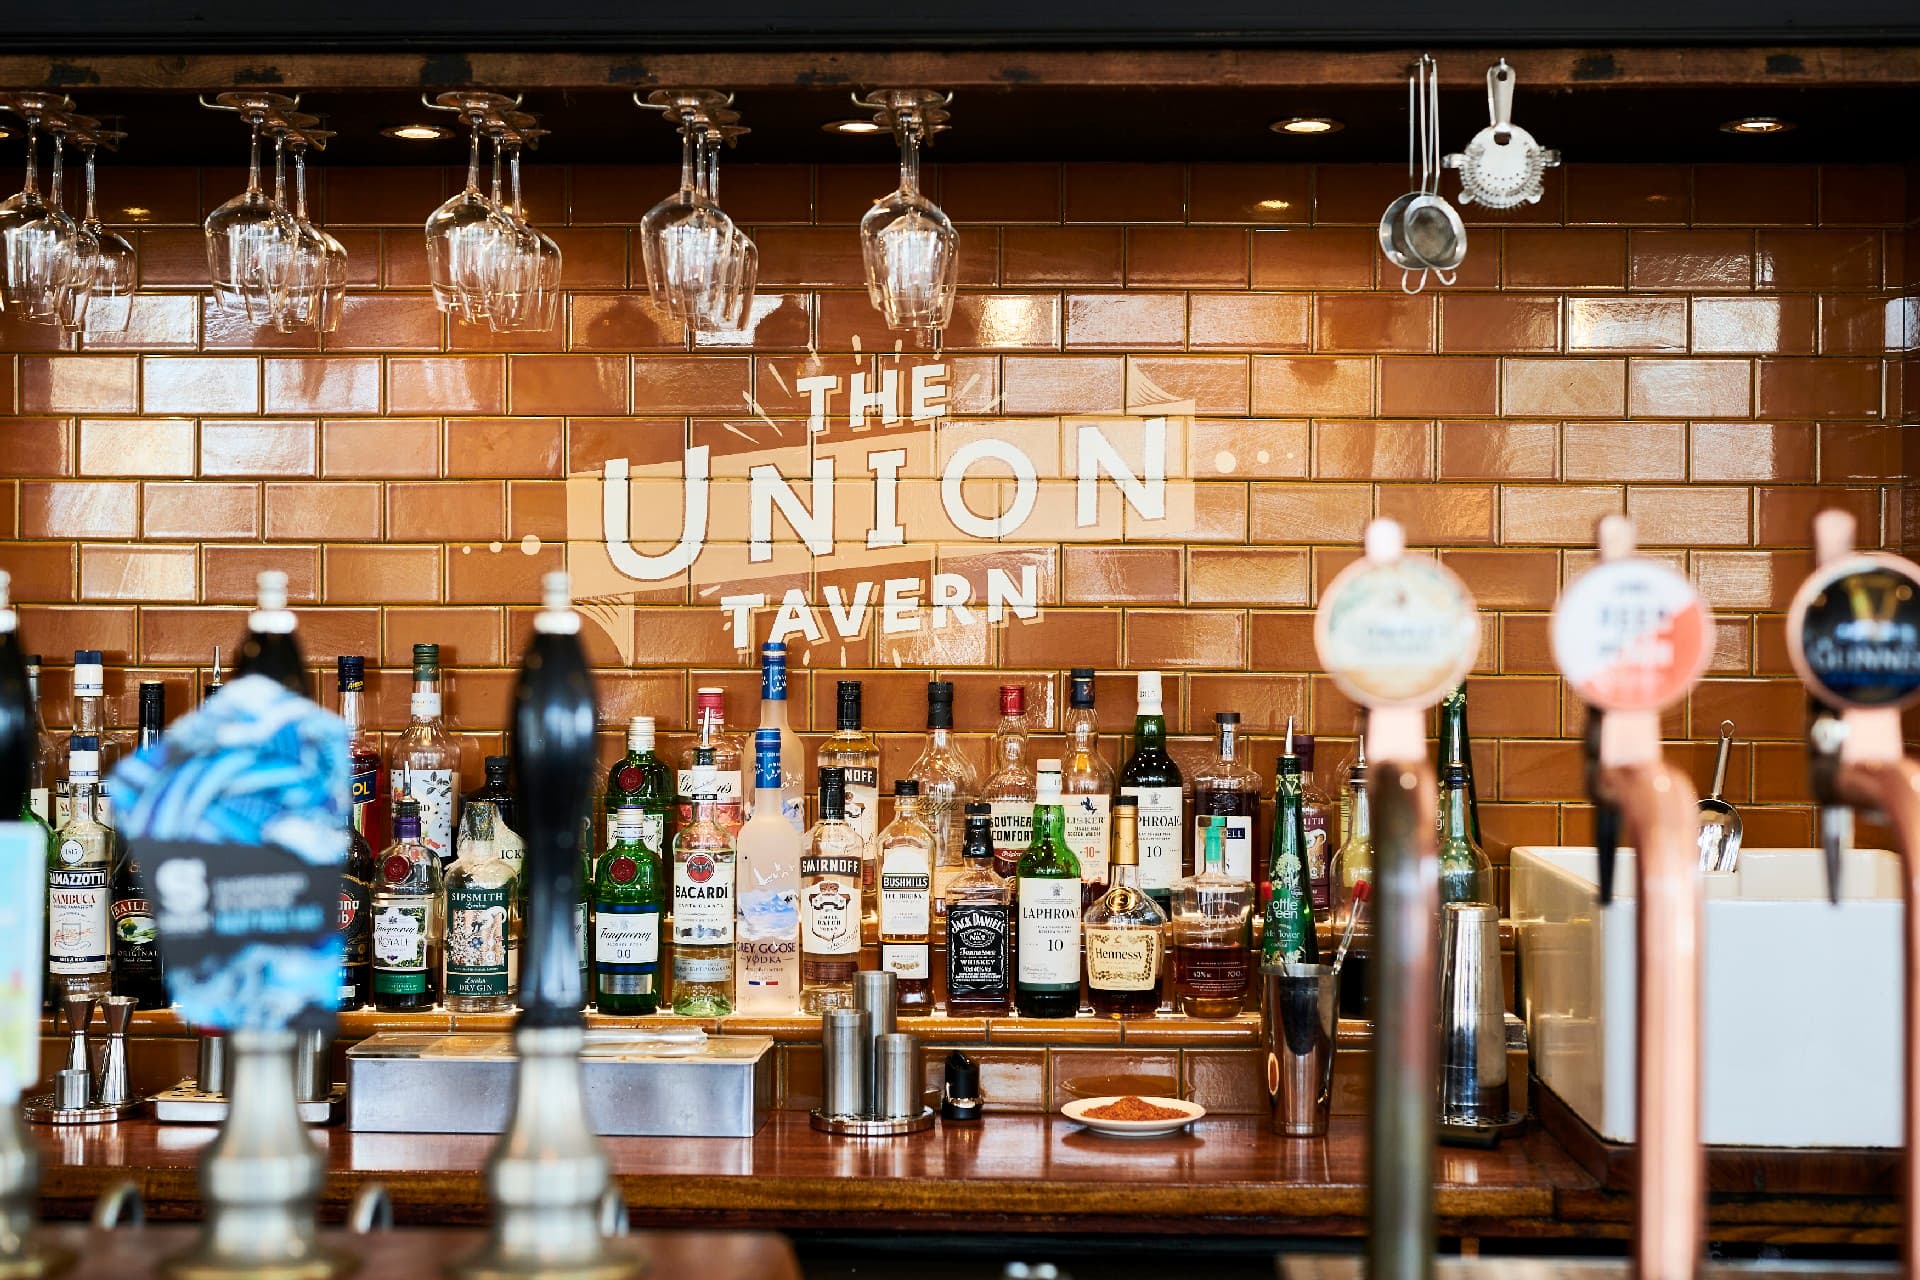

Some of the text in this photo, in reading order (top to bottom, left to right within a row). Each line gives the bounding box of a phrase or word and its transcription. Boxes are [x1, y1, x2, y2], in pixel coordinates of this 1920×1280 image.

[797, 364, 951, 434] THE
[602, 417, 1167, 581] UNION
[720, 564, 1044, 649] TAVERN
[1083, 846, 1095, 859] 10
[1146, 845, 1162, 858] 10
[883, 876, 929, 888] BUSHMILLS
[451, 891, 504, 902] SIPSMITH
[675, 882, 728, 899] BACARDÍ
[52, 893, 96, 905] SAMBUCA
[113, 900, 151, 916] BAILE
[951, 912, 1005, 934] JACK DANIEL'S
[758, 942, 797, 954] GOOSE
[1047, 938, 1064, 952] 10
[1095, 948, 1143, 961] Hennessy
[459, 984, 493, 992] DRY GIN
